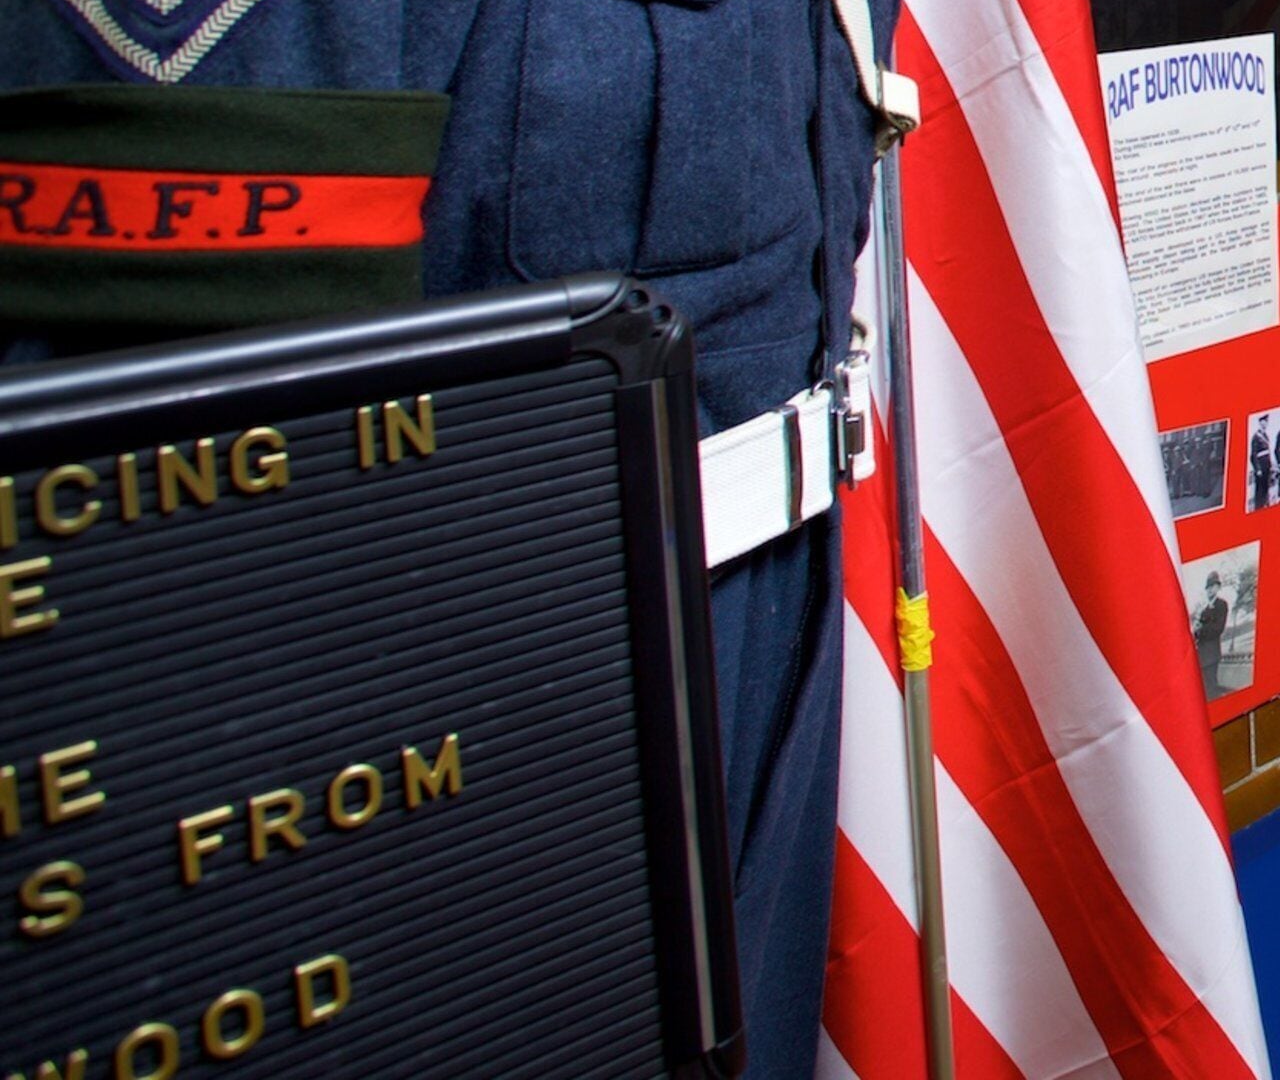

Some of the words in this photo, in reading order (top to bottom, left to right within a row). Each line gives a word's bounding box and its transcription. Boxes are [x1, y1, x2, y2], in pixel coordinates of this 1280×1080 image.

[1107, 67, 1139, 123] RAF
[1144, 51, 1265, 104] BURTONWOOD
[357, 394, 437, 469] IN
[178, 732, 464, 886] FROM
